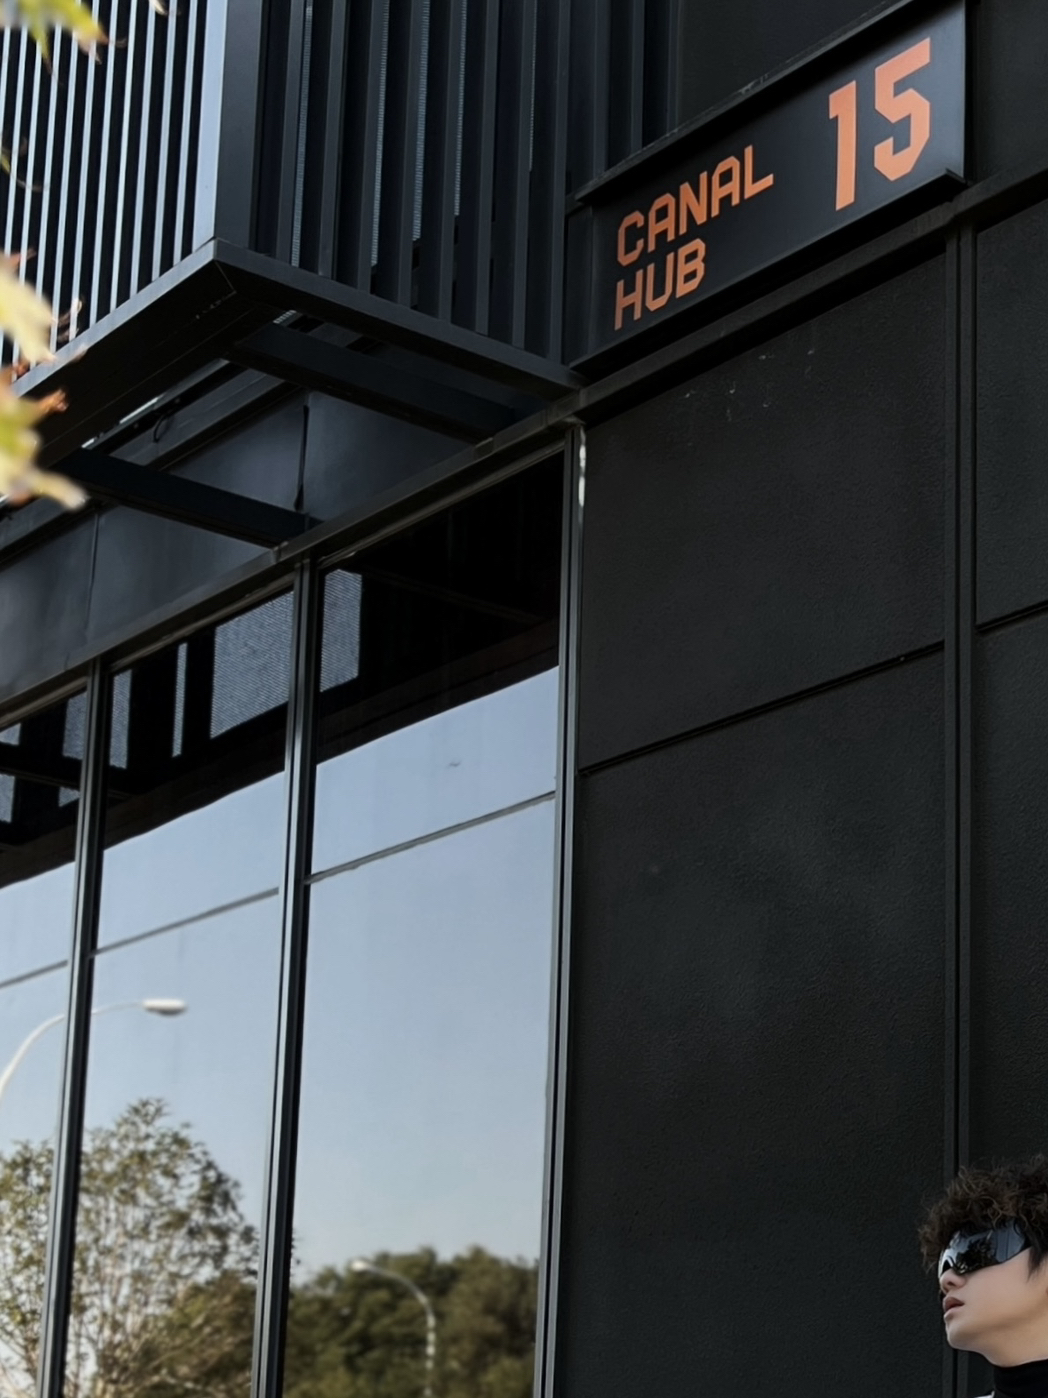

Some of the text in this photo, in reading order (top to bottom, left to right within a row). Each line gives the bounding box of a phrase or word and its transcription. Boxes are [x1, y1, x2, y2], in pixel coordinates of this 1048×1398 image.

[829, 37, 931, 211] 15
[617, 145, 774, 266] CANAL
[614, 238, 706, 331] HUB
